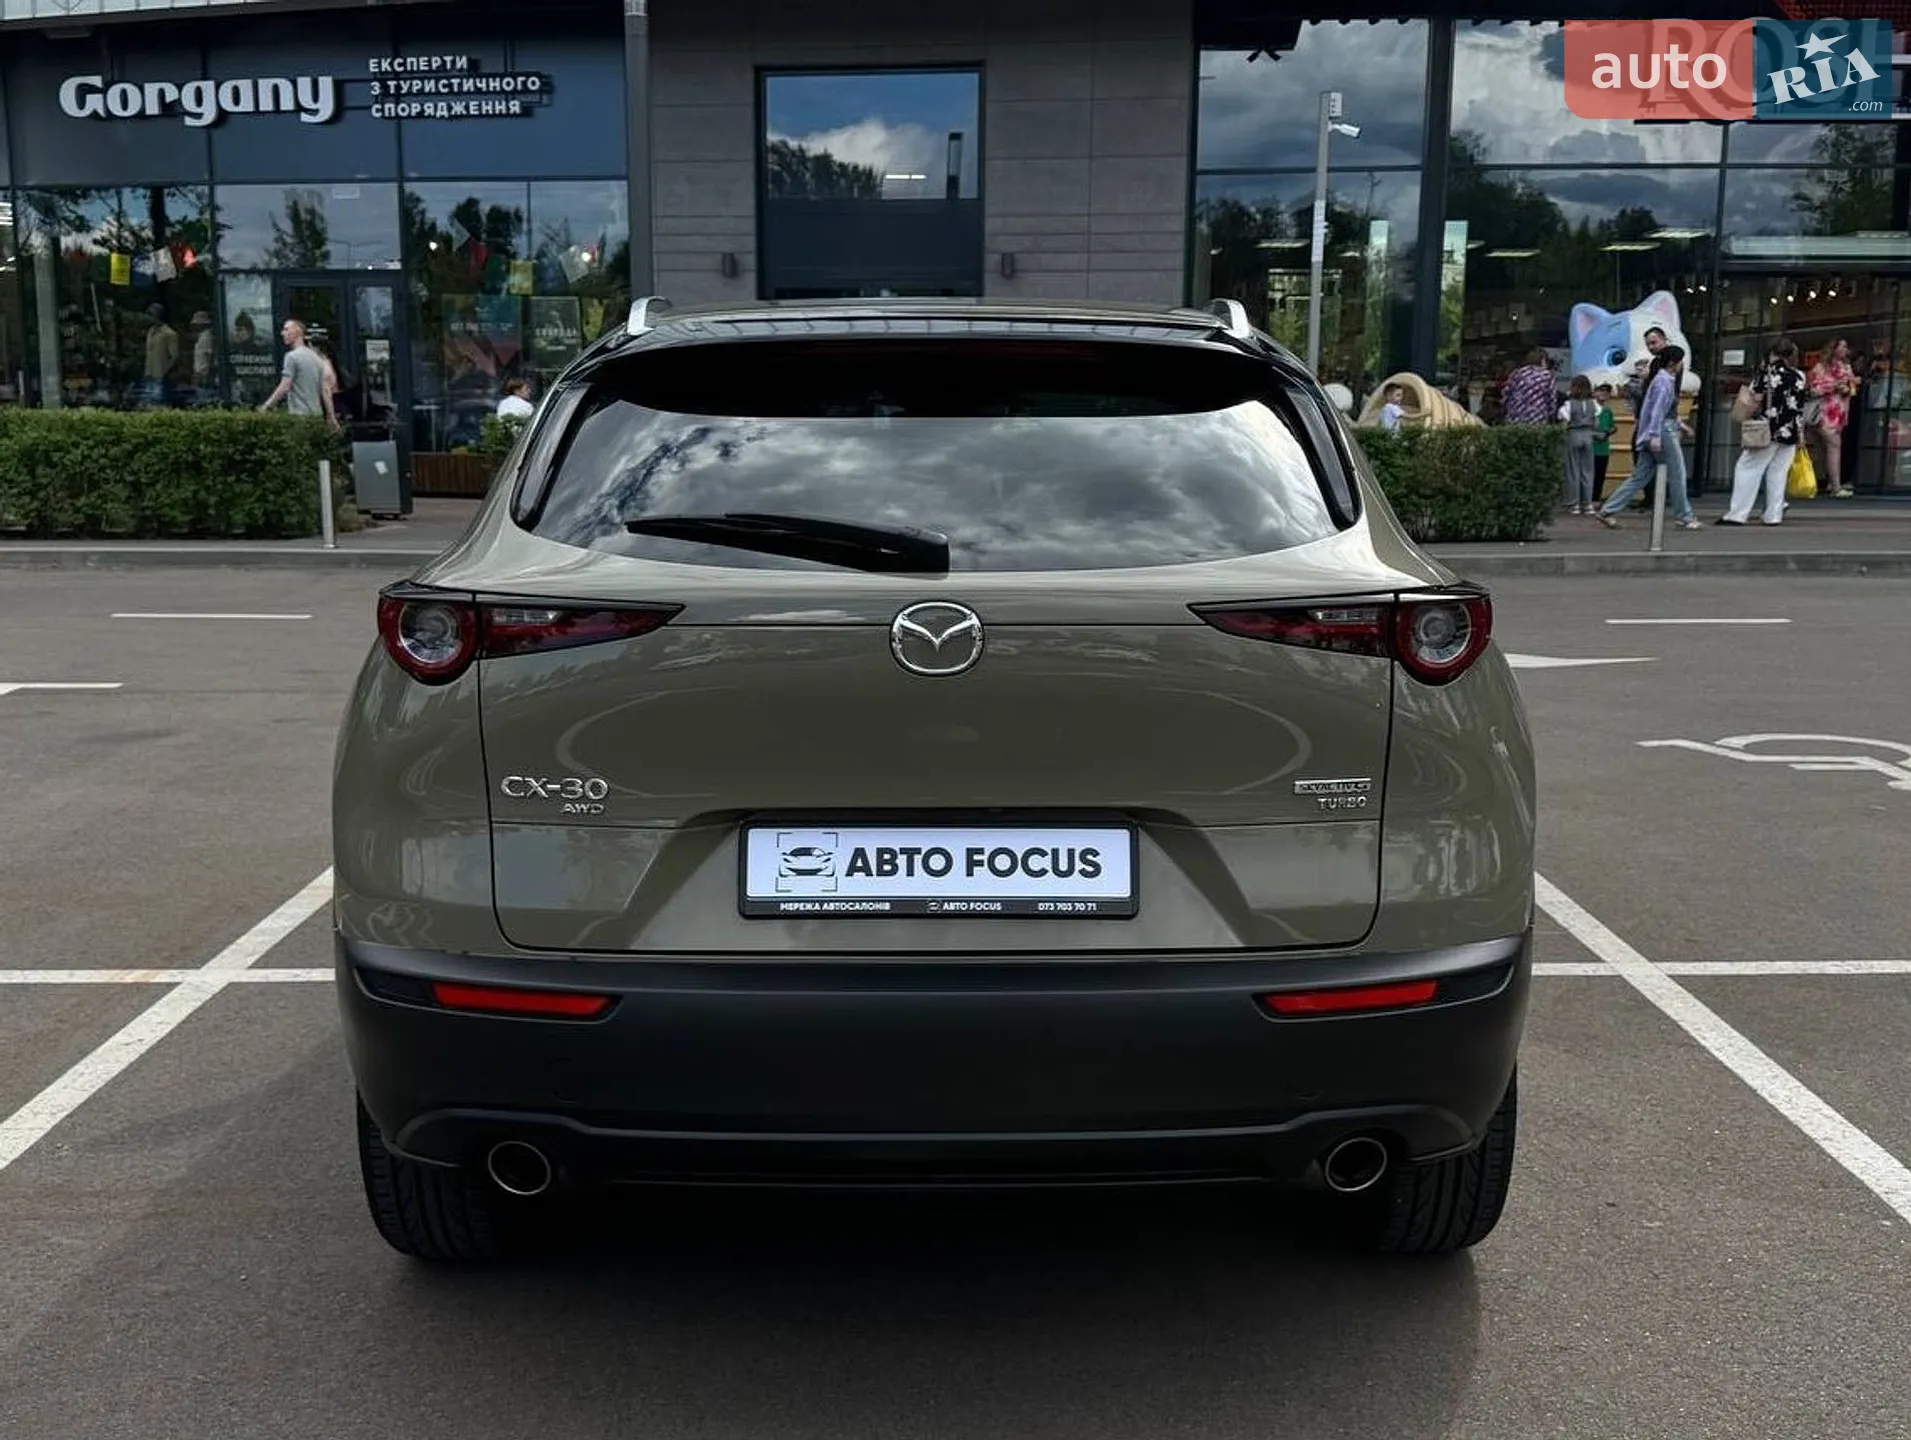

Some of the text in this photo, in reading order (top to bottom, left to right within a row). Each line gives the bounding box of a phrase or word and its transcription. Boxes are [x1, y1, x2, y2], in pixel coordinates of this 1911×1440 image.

[368, 55, 468, 73] ЕКСПЕРТИ
[387, 76, 541, 95] ТУРИСТИЧНОГО
[59, 75, 335, 127] Gorgany
[371, 100, 521, 118] СПОРЯДЖЕННЯ
[501, 776, 608, 800] CX-30
[561, 803, 604, 814] AWD
[1317, 796, 1367, 810] TURBO
[845, 847, 1102, 878] АВТО FOCUS
[780, 902, 891, 911] МЕРЕЖА АВТОСАЛОНІВ
[943, 902, 1002, 911] АВТО FOCUS
